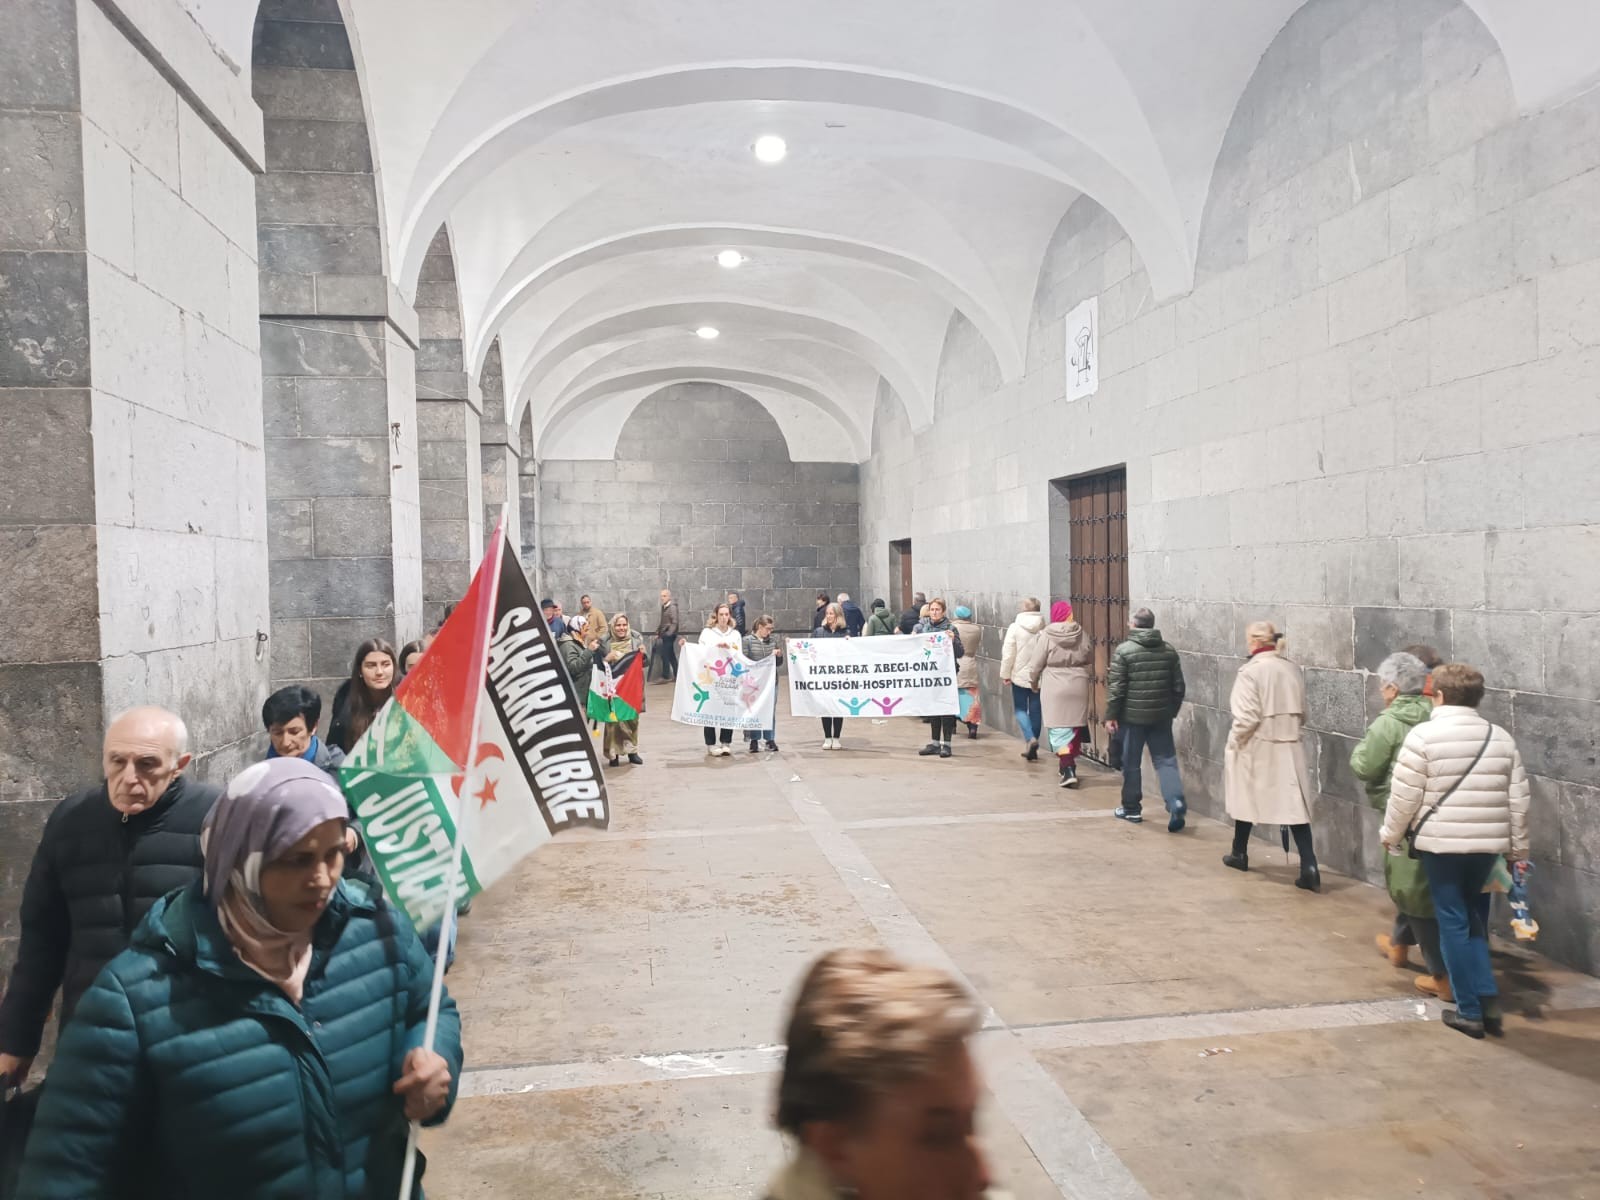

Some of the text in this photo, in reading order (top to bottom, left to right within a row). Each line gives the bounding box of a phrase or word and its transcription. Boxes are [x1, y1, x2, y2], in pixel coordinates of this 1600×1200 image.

[487, 606, 605, 824] SAHARA LIBRE
[809, 661, 938, 675] HARRERA ABEGI-ONA
